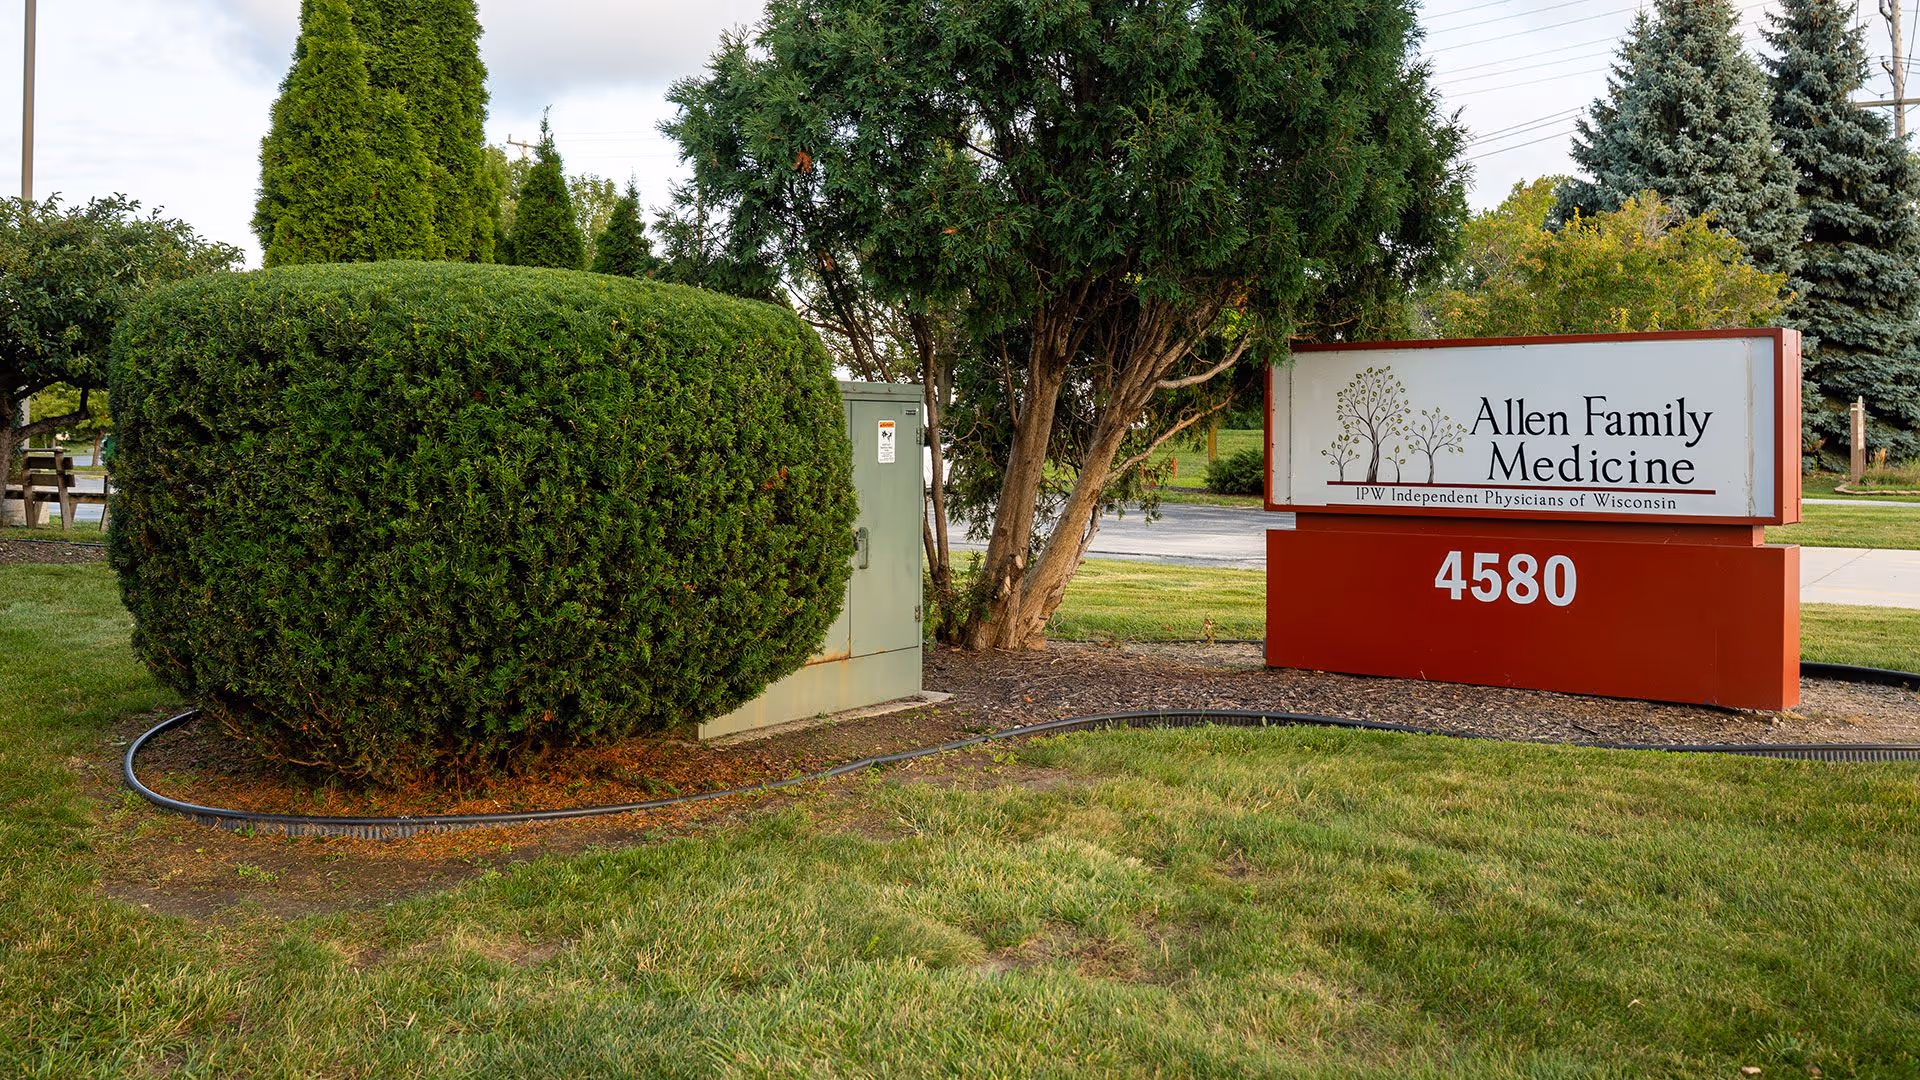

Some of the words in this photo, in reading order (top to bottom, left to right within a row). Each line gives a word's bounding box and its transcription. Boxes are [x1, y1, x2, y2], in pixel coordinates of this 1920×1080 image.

[1468, 396, 1570, 436] Allen
[1582, 395, 1714, 448] Family
[1486, 440, 1695, 485] Medicine
[1356, 486, 1386, 501] IPW
[1391, 487, 1479, 507] Independent
[1485, 489, 1564, 509] Physicians
[1569, 493, 1586, 507] of
[1592, 492, 1677, 510] Wisconsin
[1434, 550, 1577, 606] 4580
